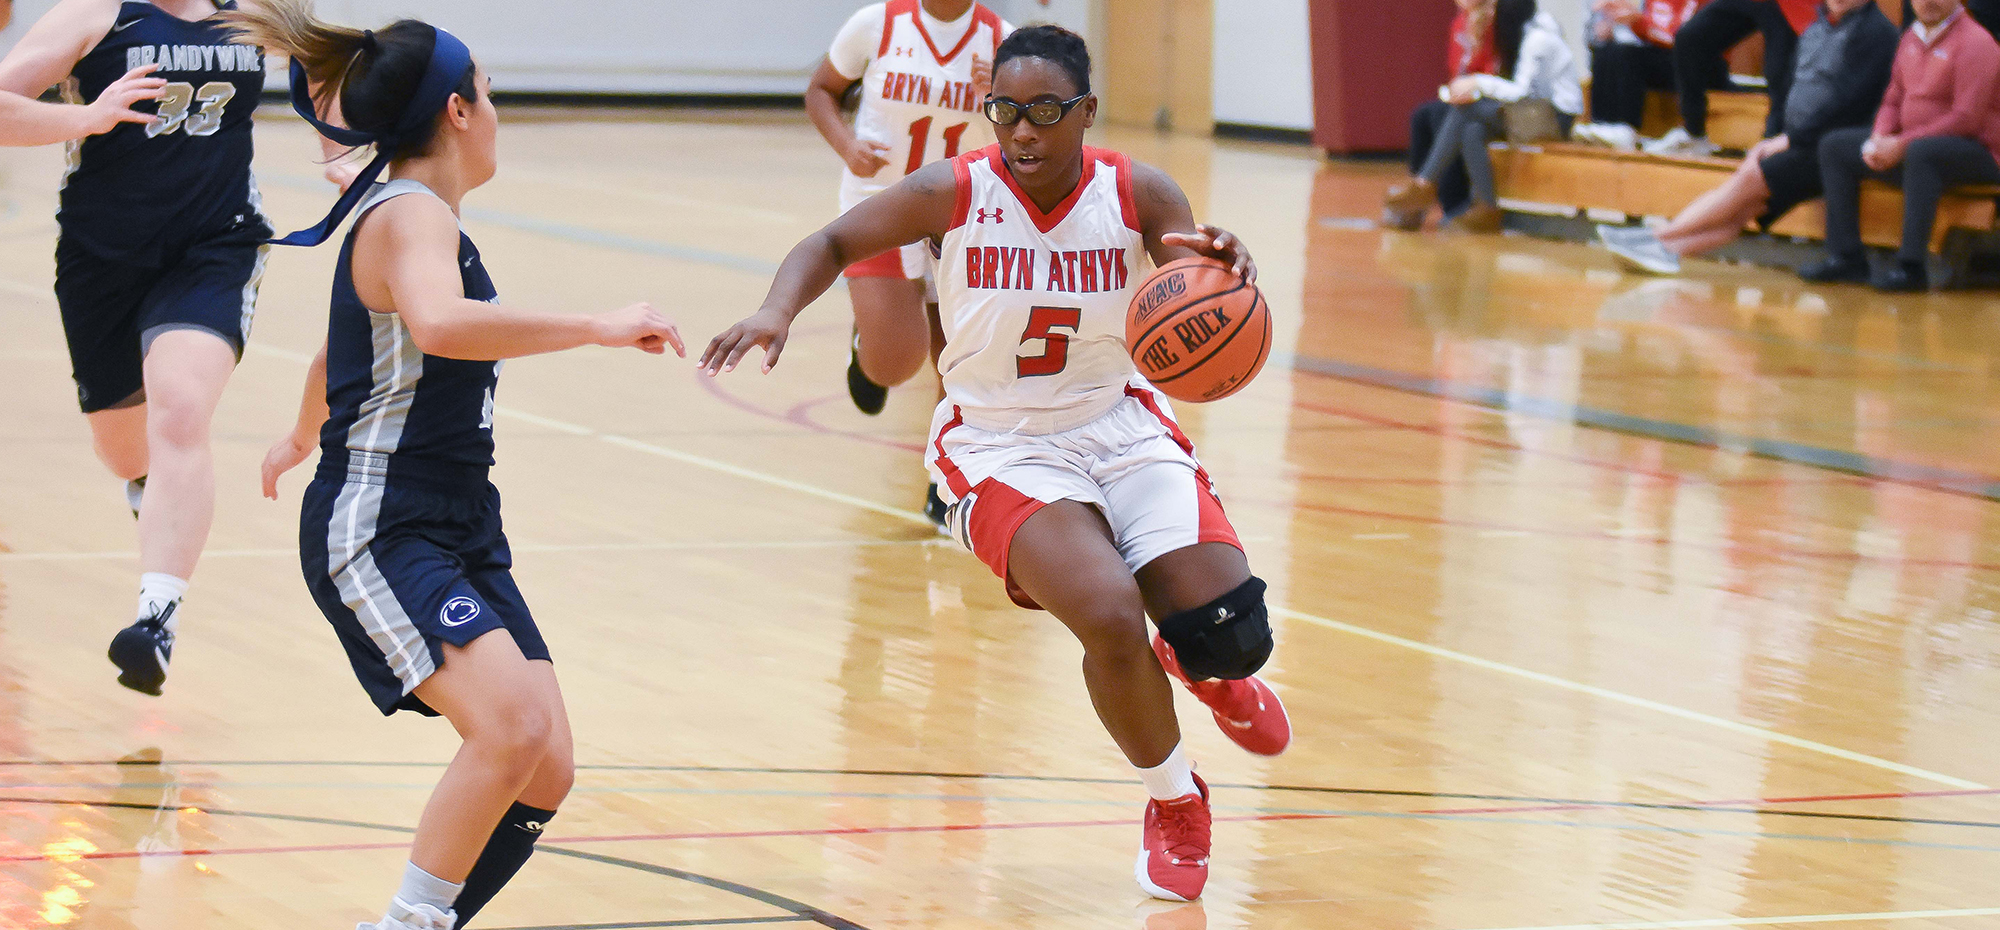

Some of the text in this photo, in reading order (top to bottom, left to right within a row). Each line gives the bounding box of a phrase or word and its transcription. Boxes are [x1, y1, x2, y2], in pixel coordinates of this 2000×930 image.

[144, 81, 237, 139] 33
[882, 71, 983, 113] BRYN ATH
[905, 115, 969, 175] 11
[966, 246, 1128, 293] BRYN ATHYN
[1016, 306, 1082, 379] 5
[1141, 306, 1232, 373] THE ROCK
